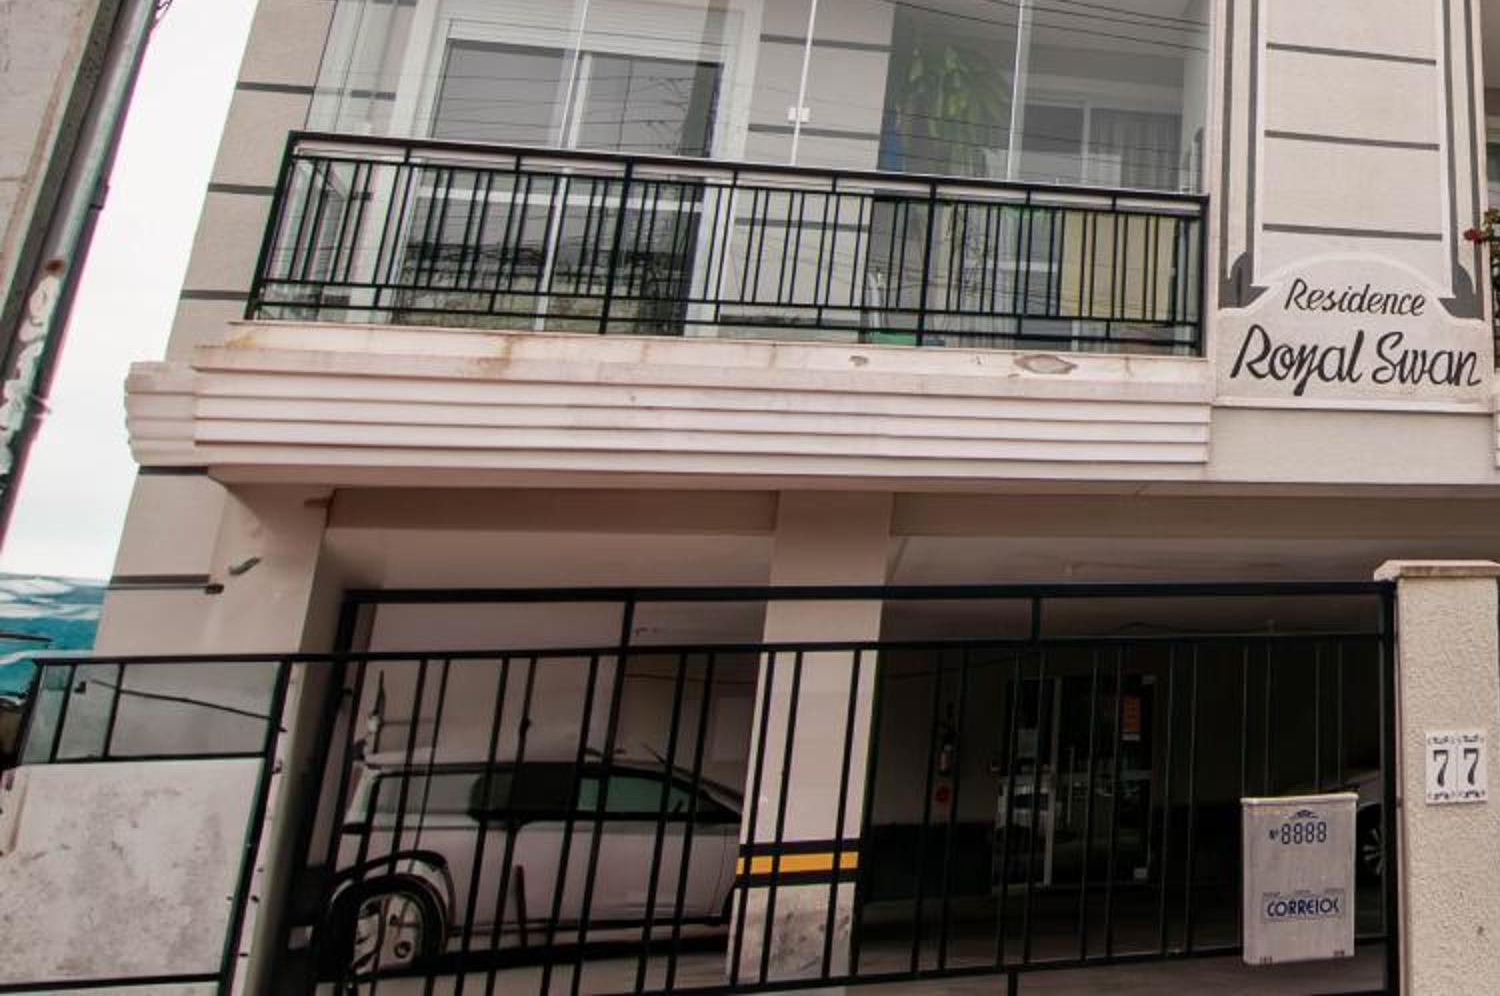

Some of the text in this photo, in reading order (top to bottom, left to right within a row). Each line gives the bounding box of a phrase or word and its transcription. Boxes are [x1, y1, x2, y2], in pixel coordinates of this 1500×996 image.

[1284, 277, 1425, 317] Residence
[1229, 323, 1482, 397] Royal Swan
[1432, 748, 1480, 788] 77
